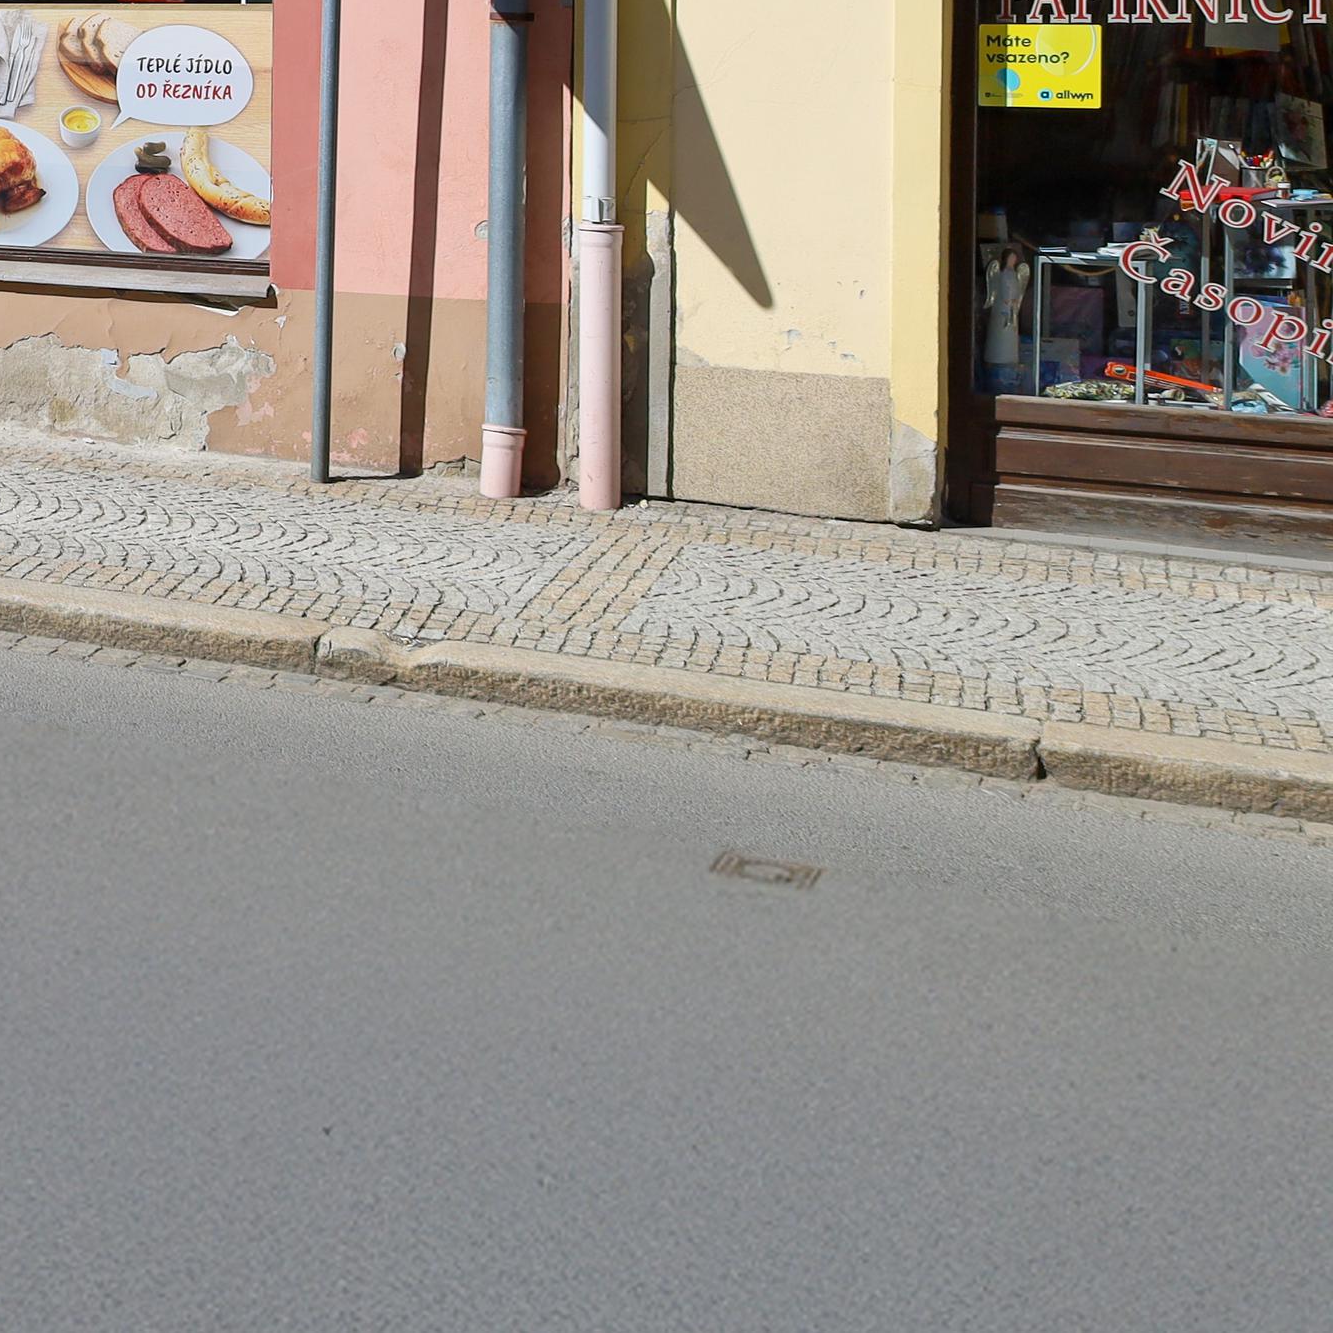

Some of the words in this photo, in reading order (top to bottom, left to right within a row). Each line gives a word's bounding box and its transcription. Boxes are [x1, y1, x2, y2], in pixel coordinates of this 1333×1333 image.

[985, 34, 1032, 47] Máte
[136, 53, 182, 74] TEPLÉ
[185, 53, 233, 75] JÍDLO
[985, 51, 1070, 64] vsazeno?
[136, 82, 158, 99] OD
[162, 79, 233, 100] ŘEZNÍKA
[1055, 90, 1094, 102] allwyn
[1118, 231, 1333, 364] Časopi
